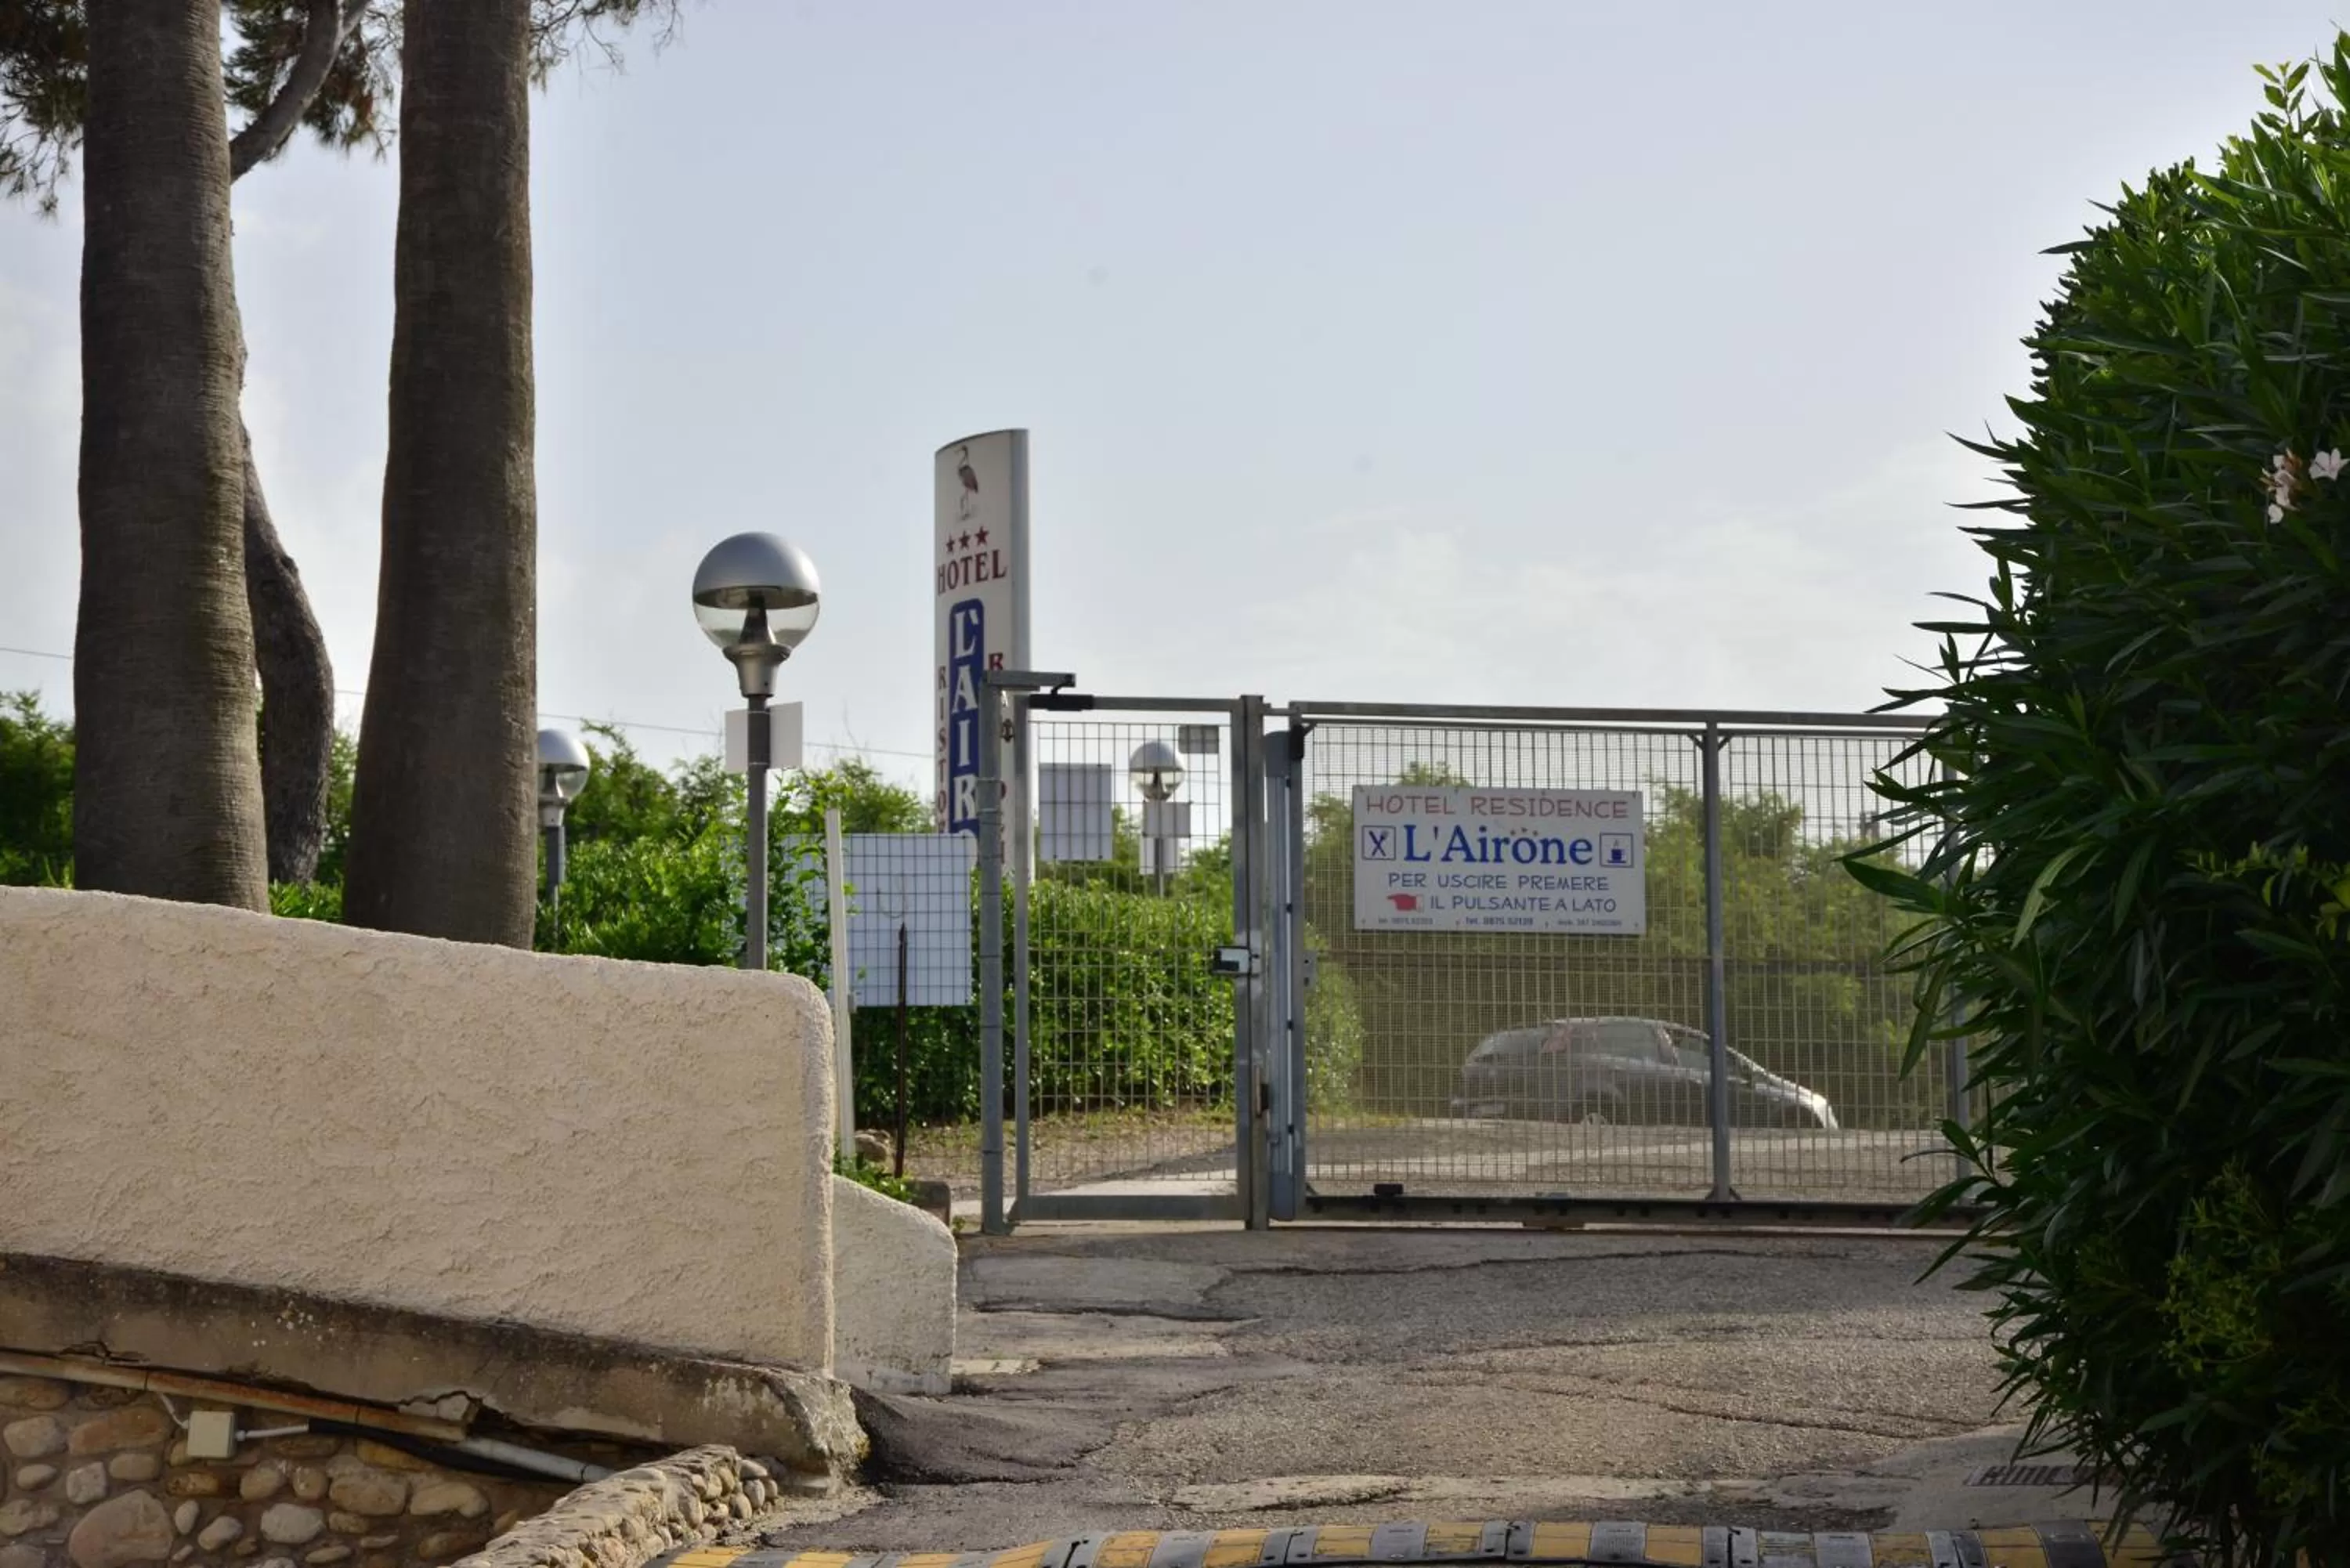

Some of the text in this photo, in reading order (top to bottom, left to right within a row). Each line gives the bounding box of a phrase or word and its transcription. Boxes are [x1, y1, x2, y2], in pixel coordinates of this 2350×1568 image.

[938, 550, 1007, 596] HOTEL
[1365, 794, 1629, 819] HOTEL RESIDENCE
[1403, 824, 1593, 865] L'Airone
[1388, 872, 1611, 891] PER USCIRE PREMERE
[1430, 895, 1618, 913] IL PULSANTE A LATO
